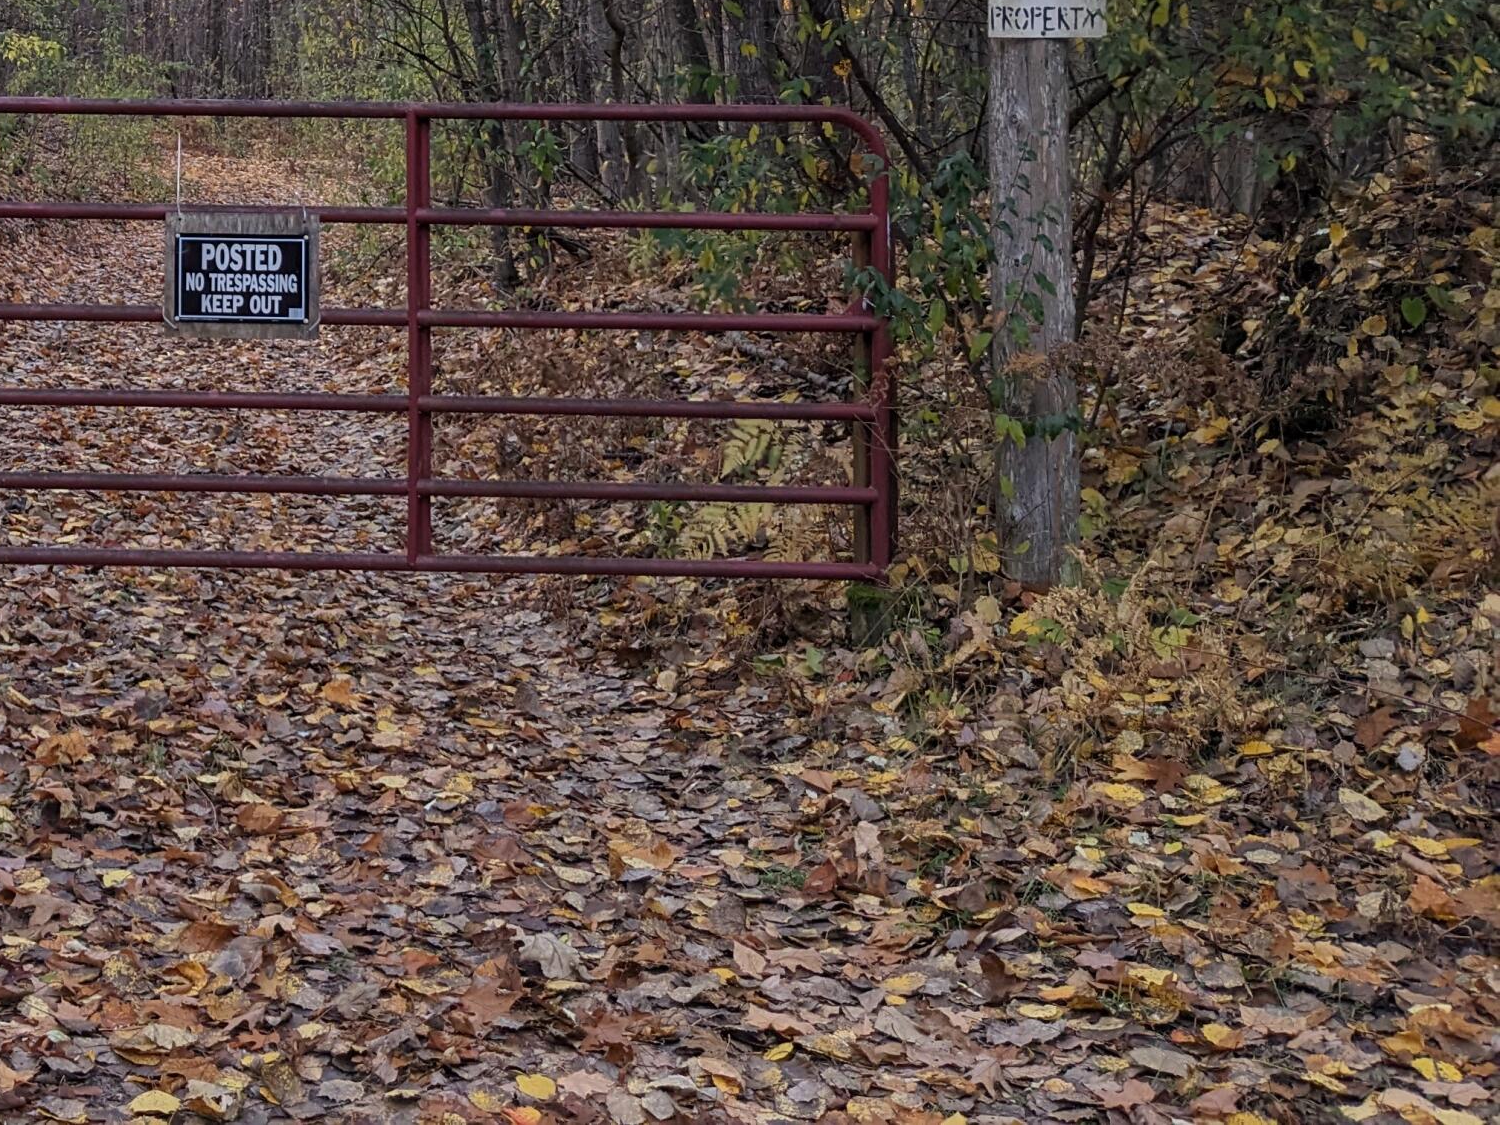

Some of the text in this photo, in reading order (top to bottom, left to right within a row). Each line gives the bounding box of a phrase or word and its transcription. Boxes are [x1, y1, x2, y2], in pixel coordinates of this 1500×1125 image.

[990, 6, 1104, 31] PROPERTY
[201, 243, 282, 271] POSTED
[185, 272, 298, 293] NO TRESPASSING
[201, 294, 283, 315] KEEP OUT
